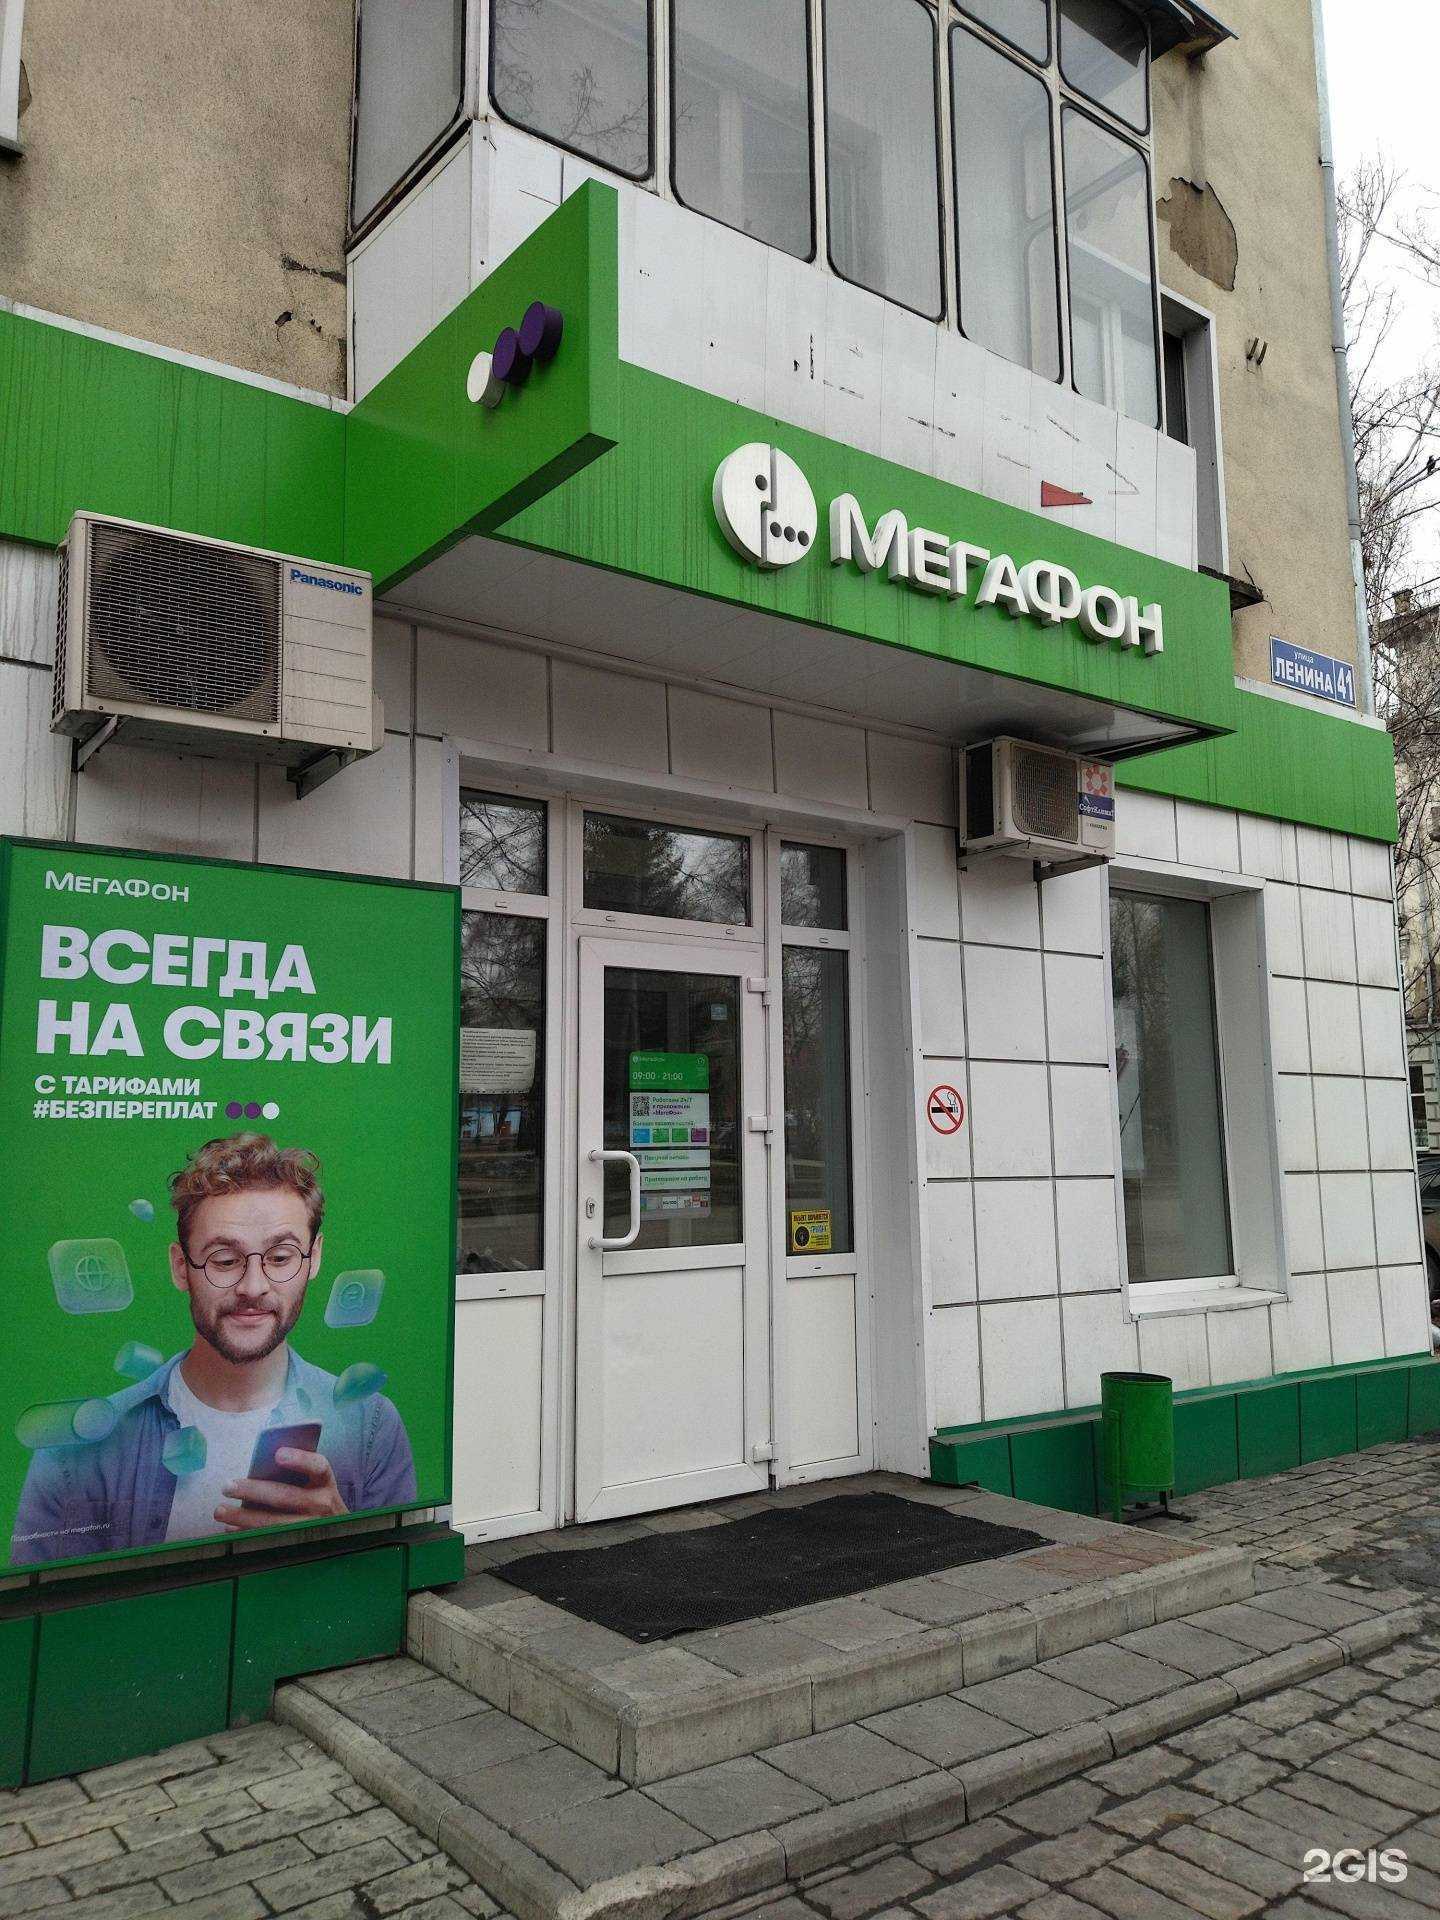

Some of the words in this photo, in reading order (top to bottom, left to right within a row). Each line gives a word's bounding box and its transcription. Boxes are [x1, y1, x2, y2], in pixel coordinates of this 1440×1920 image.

[290, 568, 363, 595] Panasonic
[1275, 656, 1334, 694] ЛЕНИНА
[1337, 666, 1354, 702] 41
[40, 924, 317, 1000] ВСЕГДА
[36, 999, 144, 1057] НА
[163, 1005, 393, 1065] СВЯЗИ
[34, 1075, 55, 1094] С
[61, 1075, 200, 1096] ТАРИФАМИ
[632, 1071, 656, 1080] 09:00
[662, 1072, 684, 1081] 21:00
[33, 1100, 218, 1120] #БЕЗПЕРЕПЛАТ
